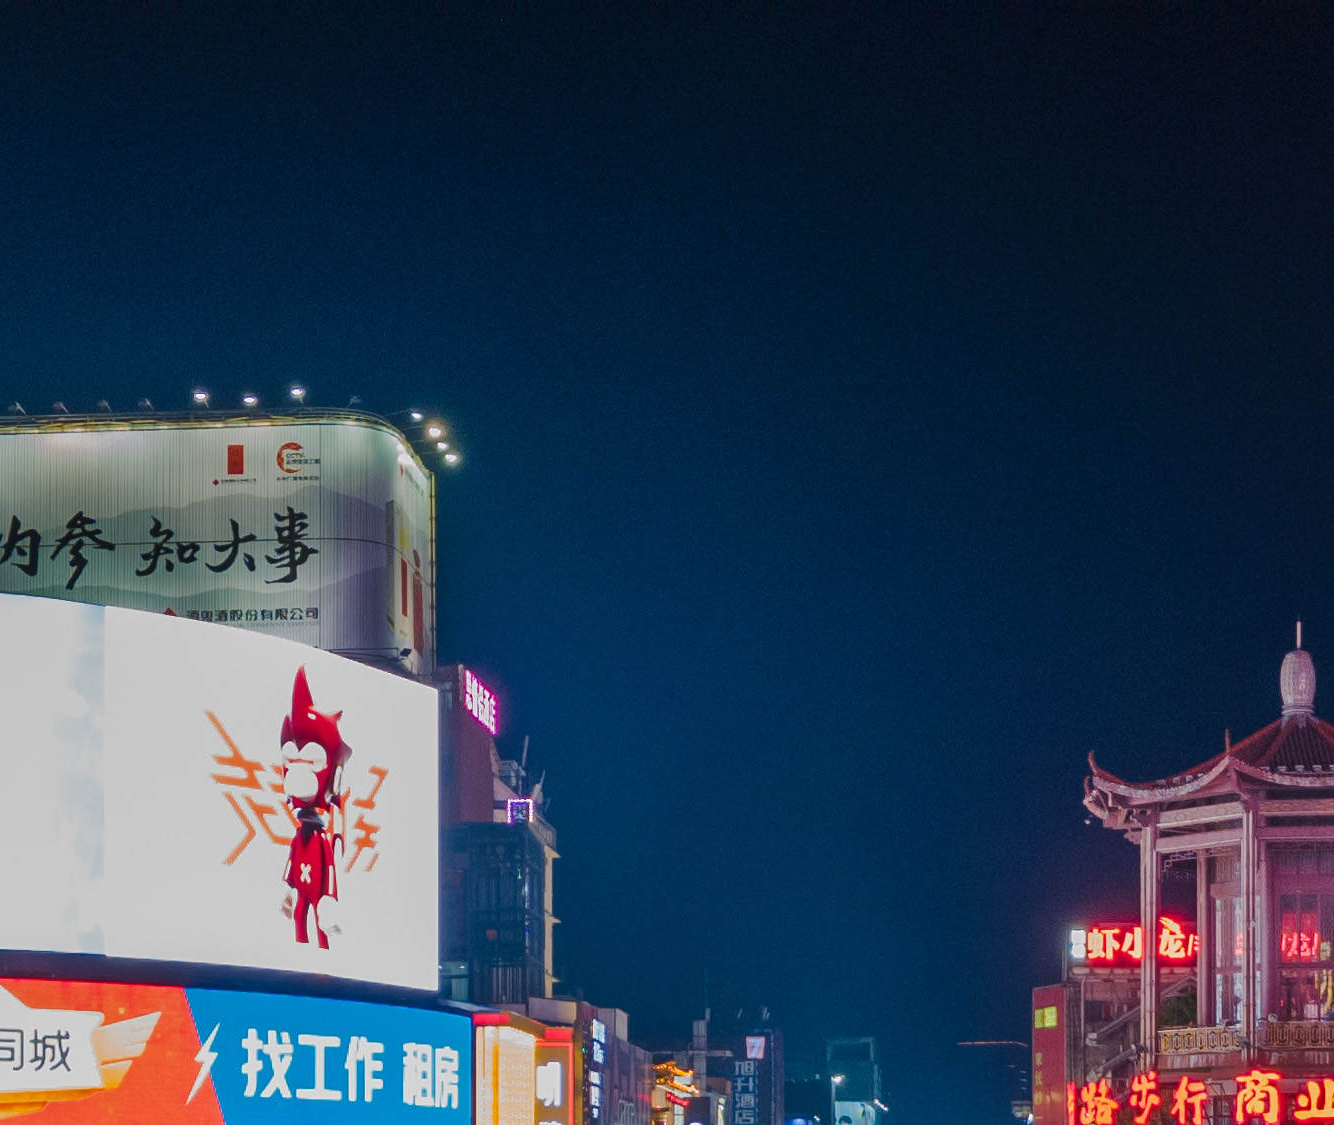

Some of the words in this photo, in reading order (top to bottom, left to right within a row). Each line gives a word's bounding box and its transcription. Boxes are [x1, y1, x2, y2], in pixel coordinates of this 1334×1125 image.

[136, 506, 319, 584] 知大事
[241, 1028, 384, 1101] 找工作
[402, 1042, 459, 1109] 租房
